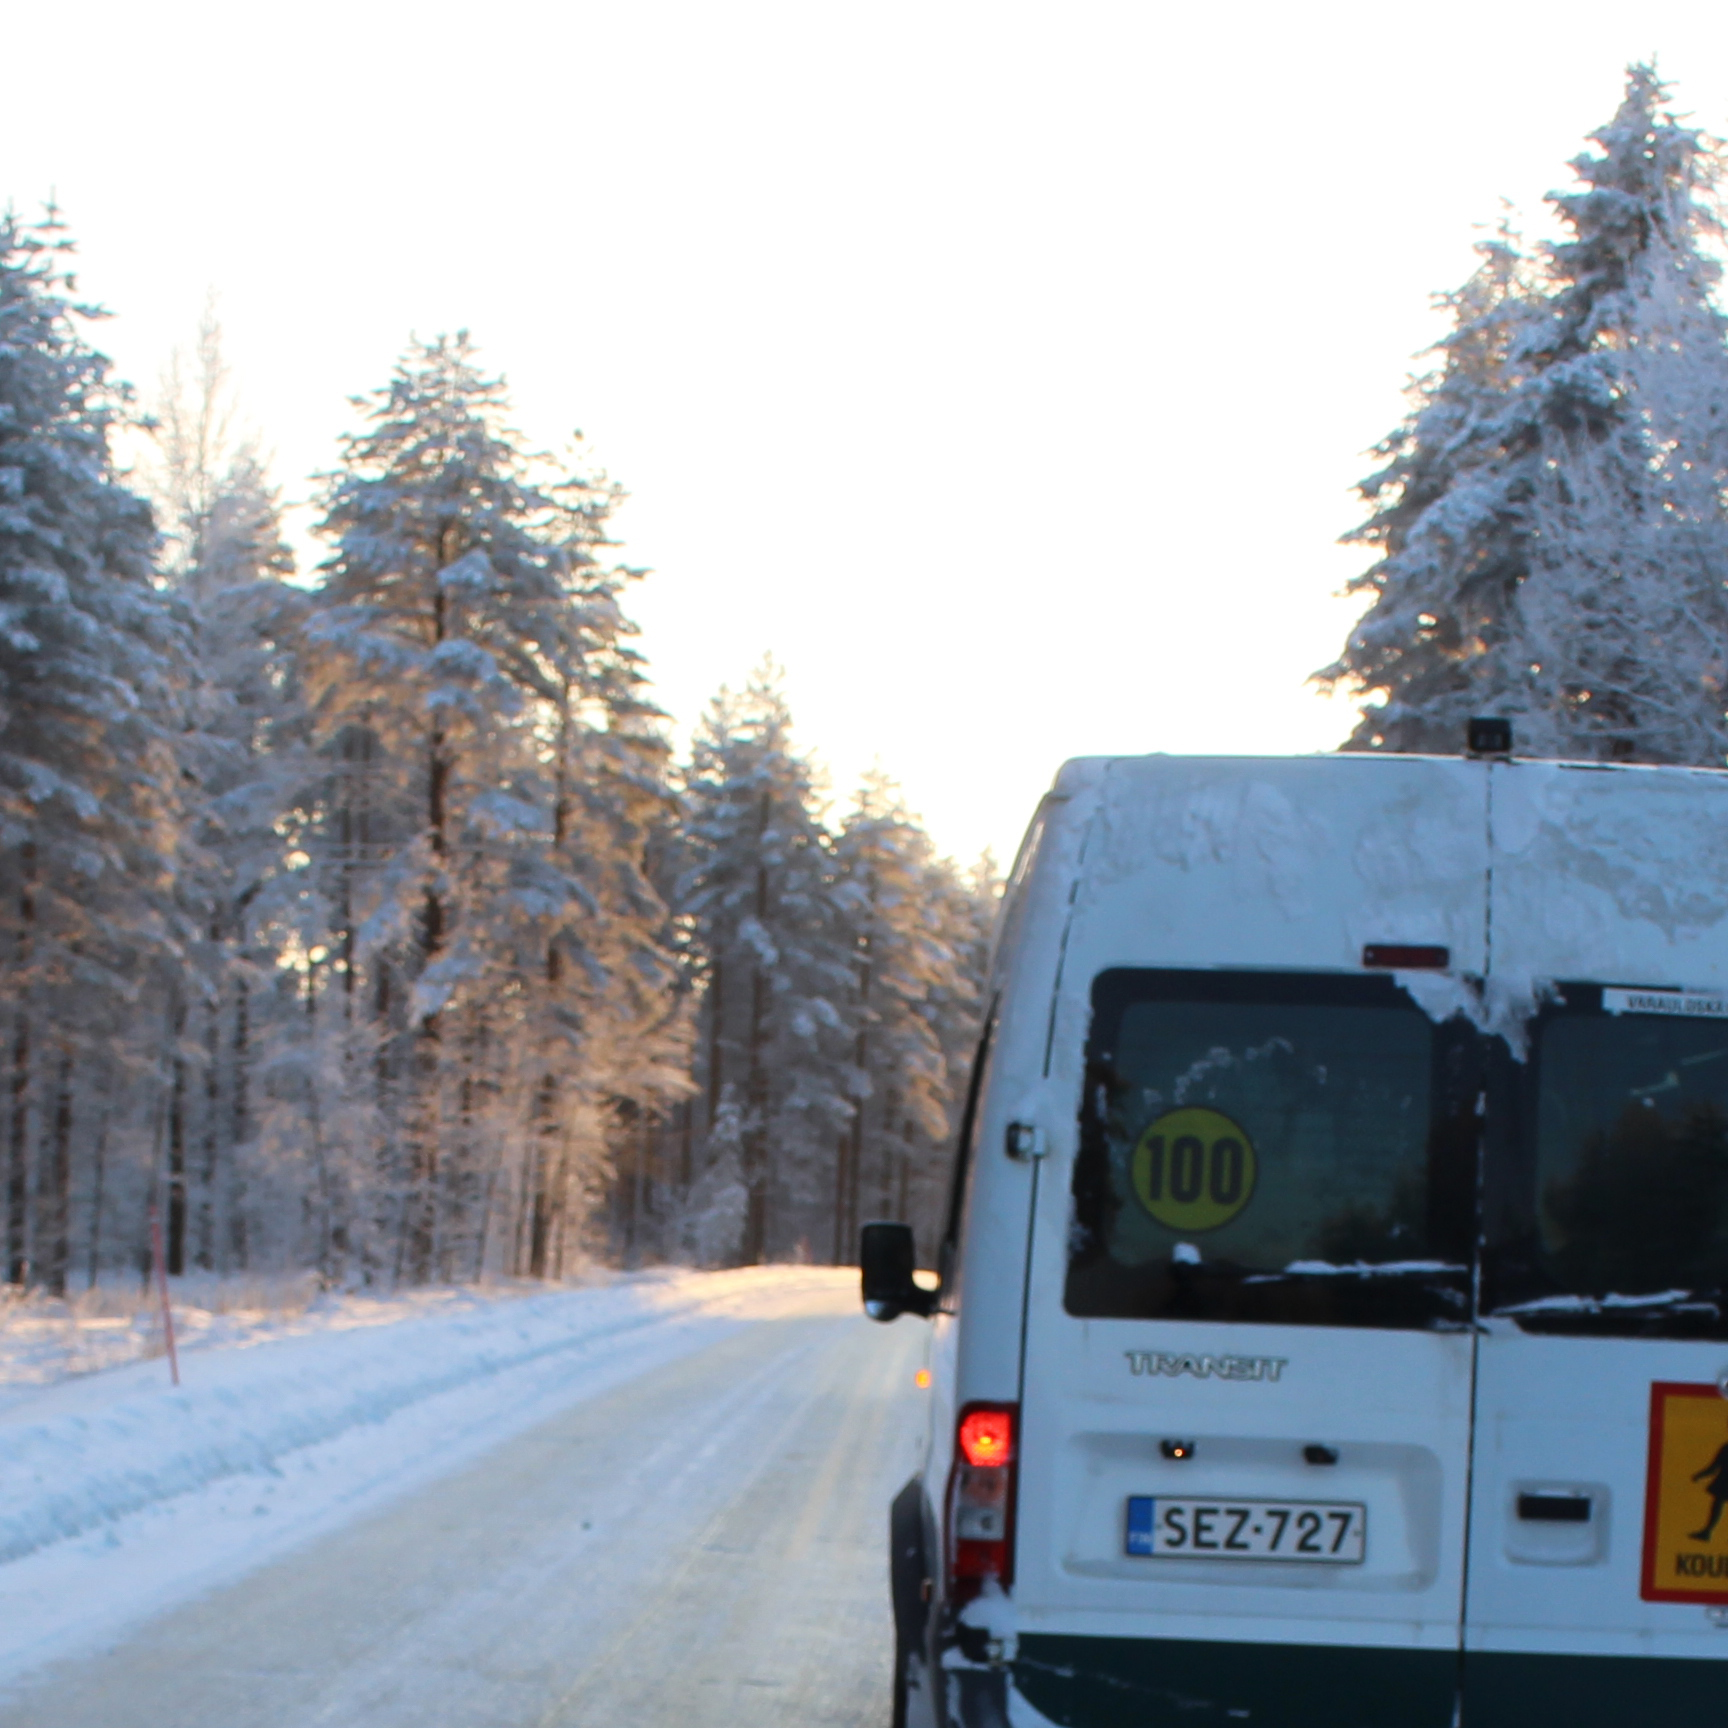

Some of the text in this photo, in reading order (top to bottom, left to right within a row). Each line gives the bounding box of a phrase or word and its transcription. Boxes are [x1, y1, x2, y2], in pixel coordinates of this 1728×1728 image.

[1146, 1134, 1244, 1205] 100
[1124, 1350, 1289, 1383] TRANSIT
[1163, 1507, 1353, 1553] SEZ-727
